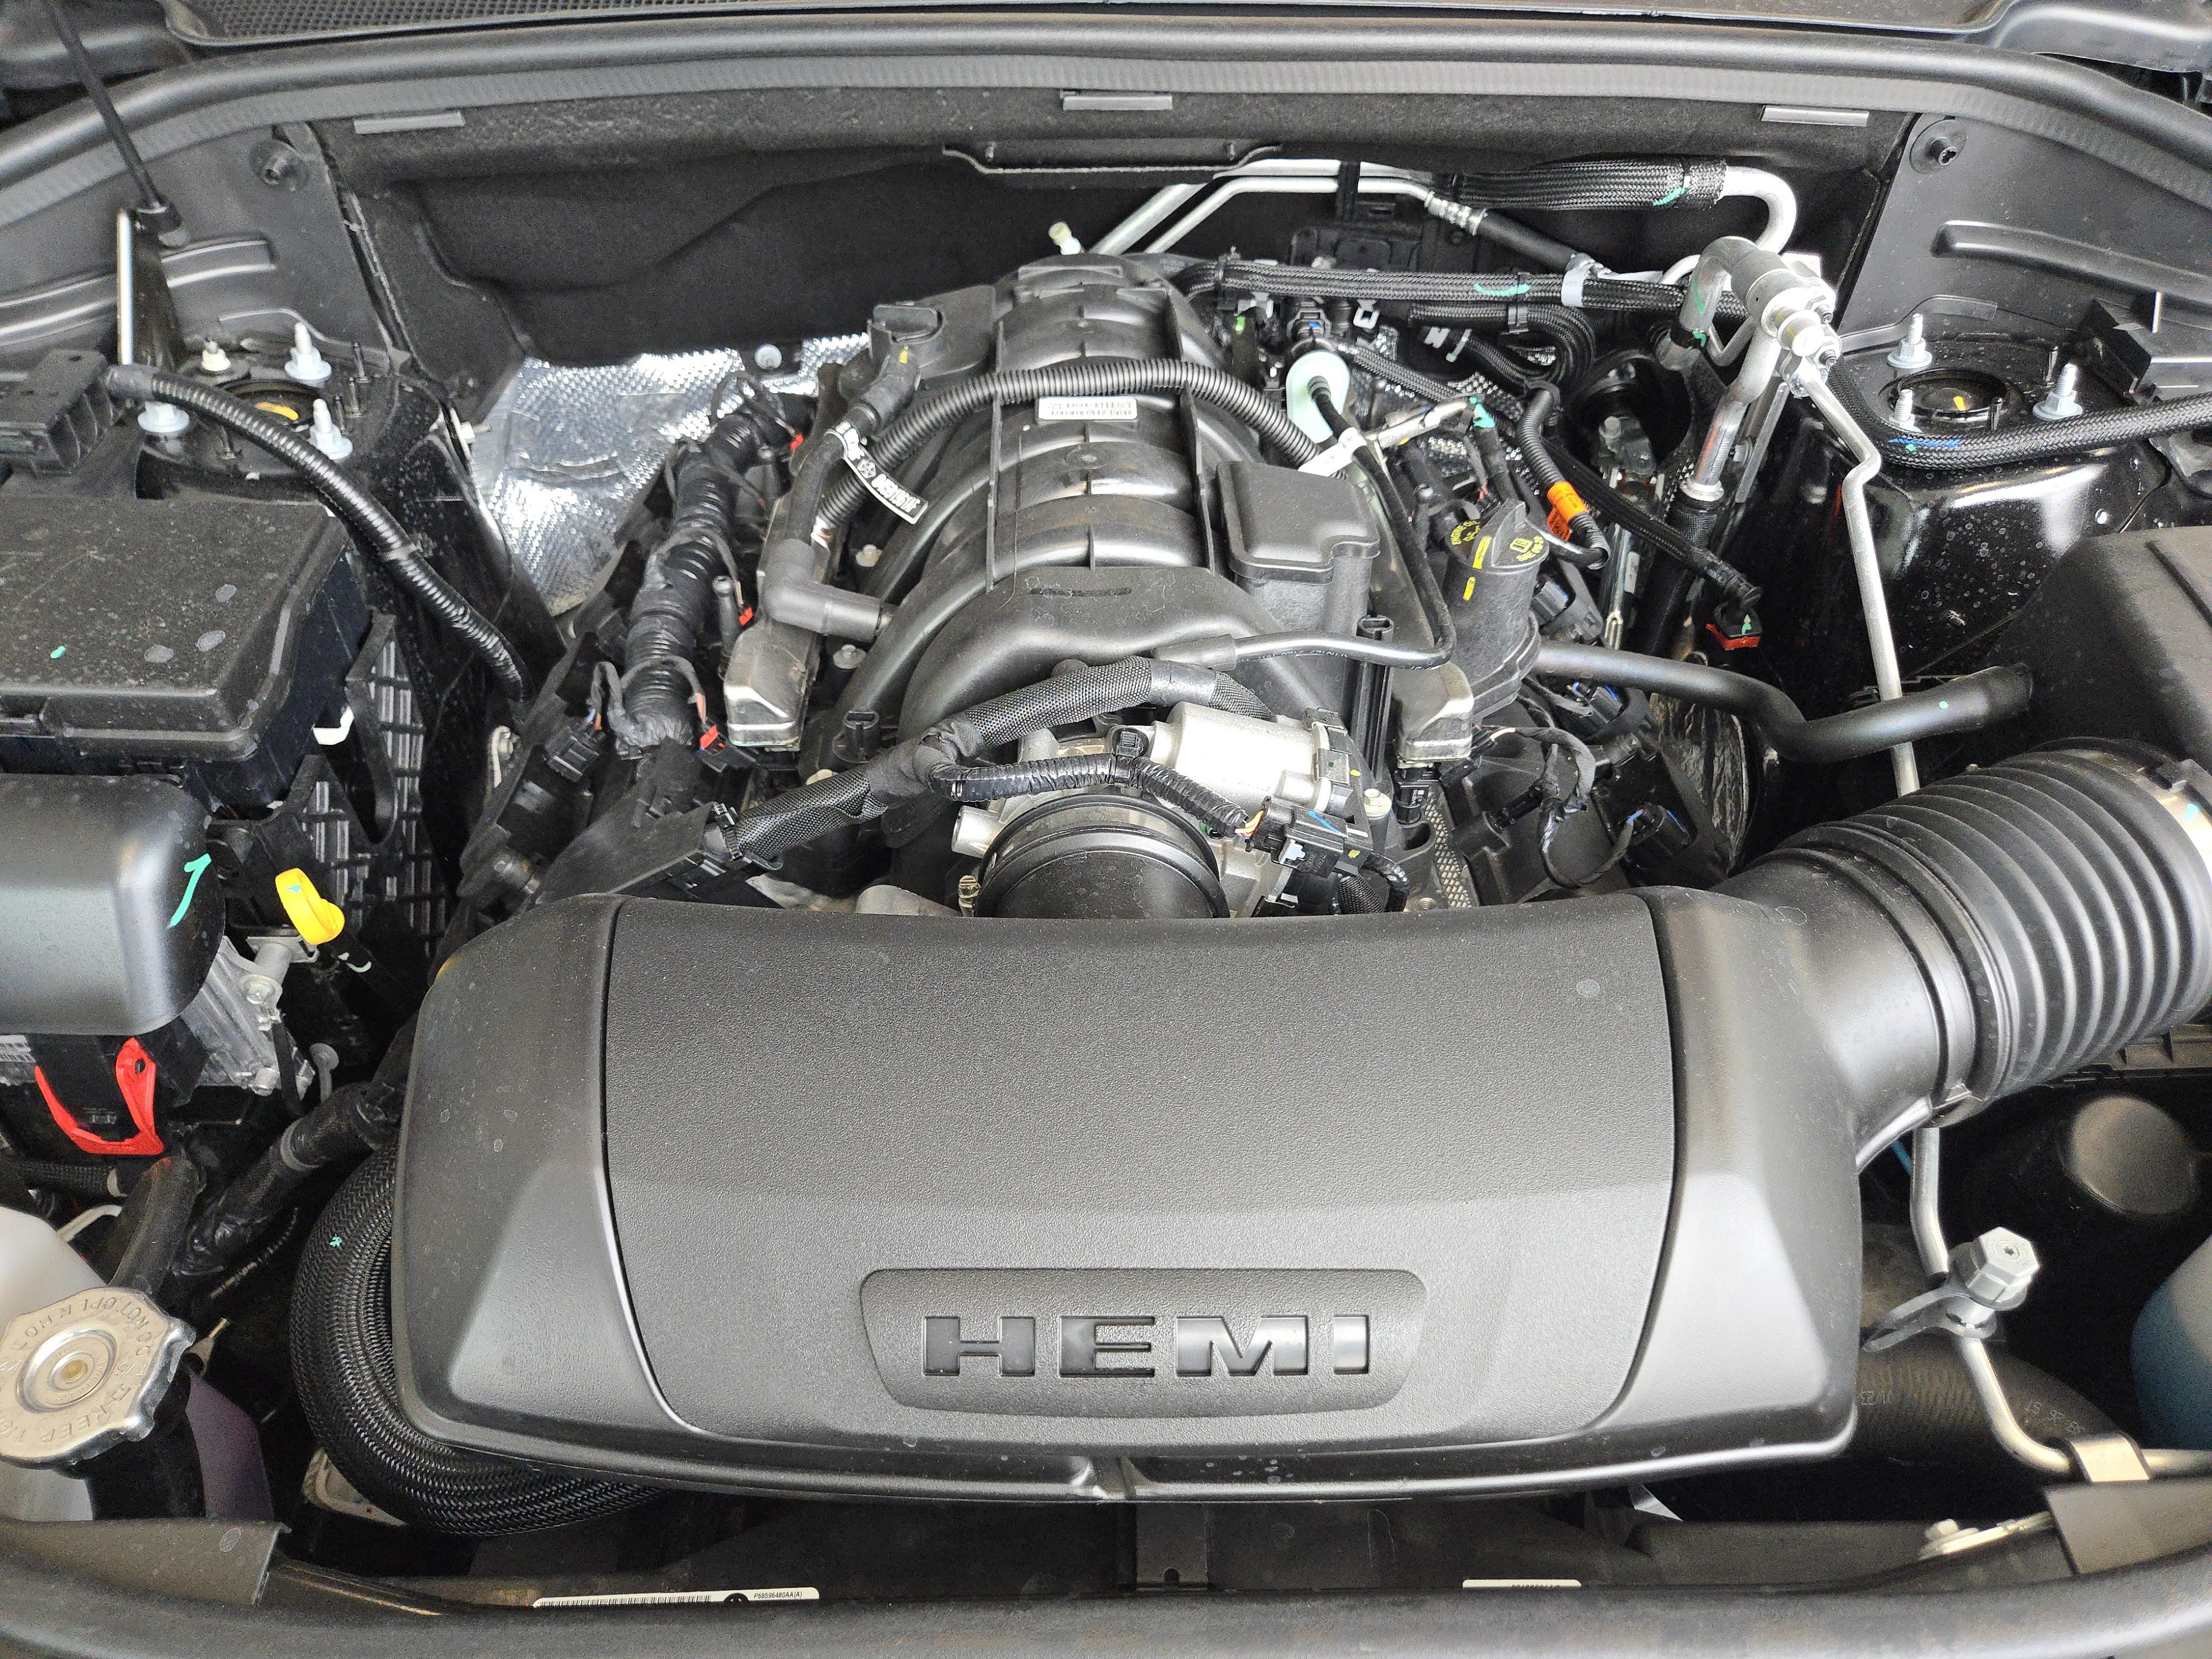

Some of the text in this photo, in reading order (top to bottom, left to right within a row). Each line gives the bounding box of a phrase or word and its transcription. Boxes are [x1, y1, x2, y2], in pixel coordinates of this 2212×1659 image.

[1450, 525, 1467, 545] ENGINE
[1515, 551, 1536, 562] SAE
[135, 1331, 152, 1357] DO
[922, 1314, 1370, 1377] HEMI
[754, 1591, 802, 1599] P68596480AA(A)
